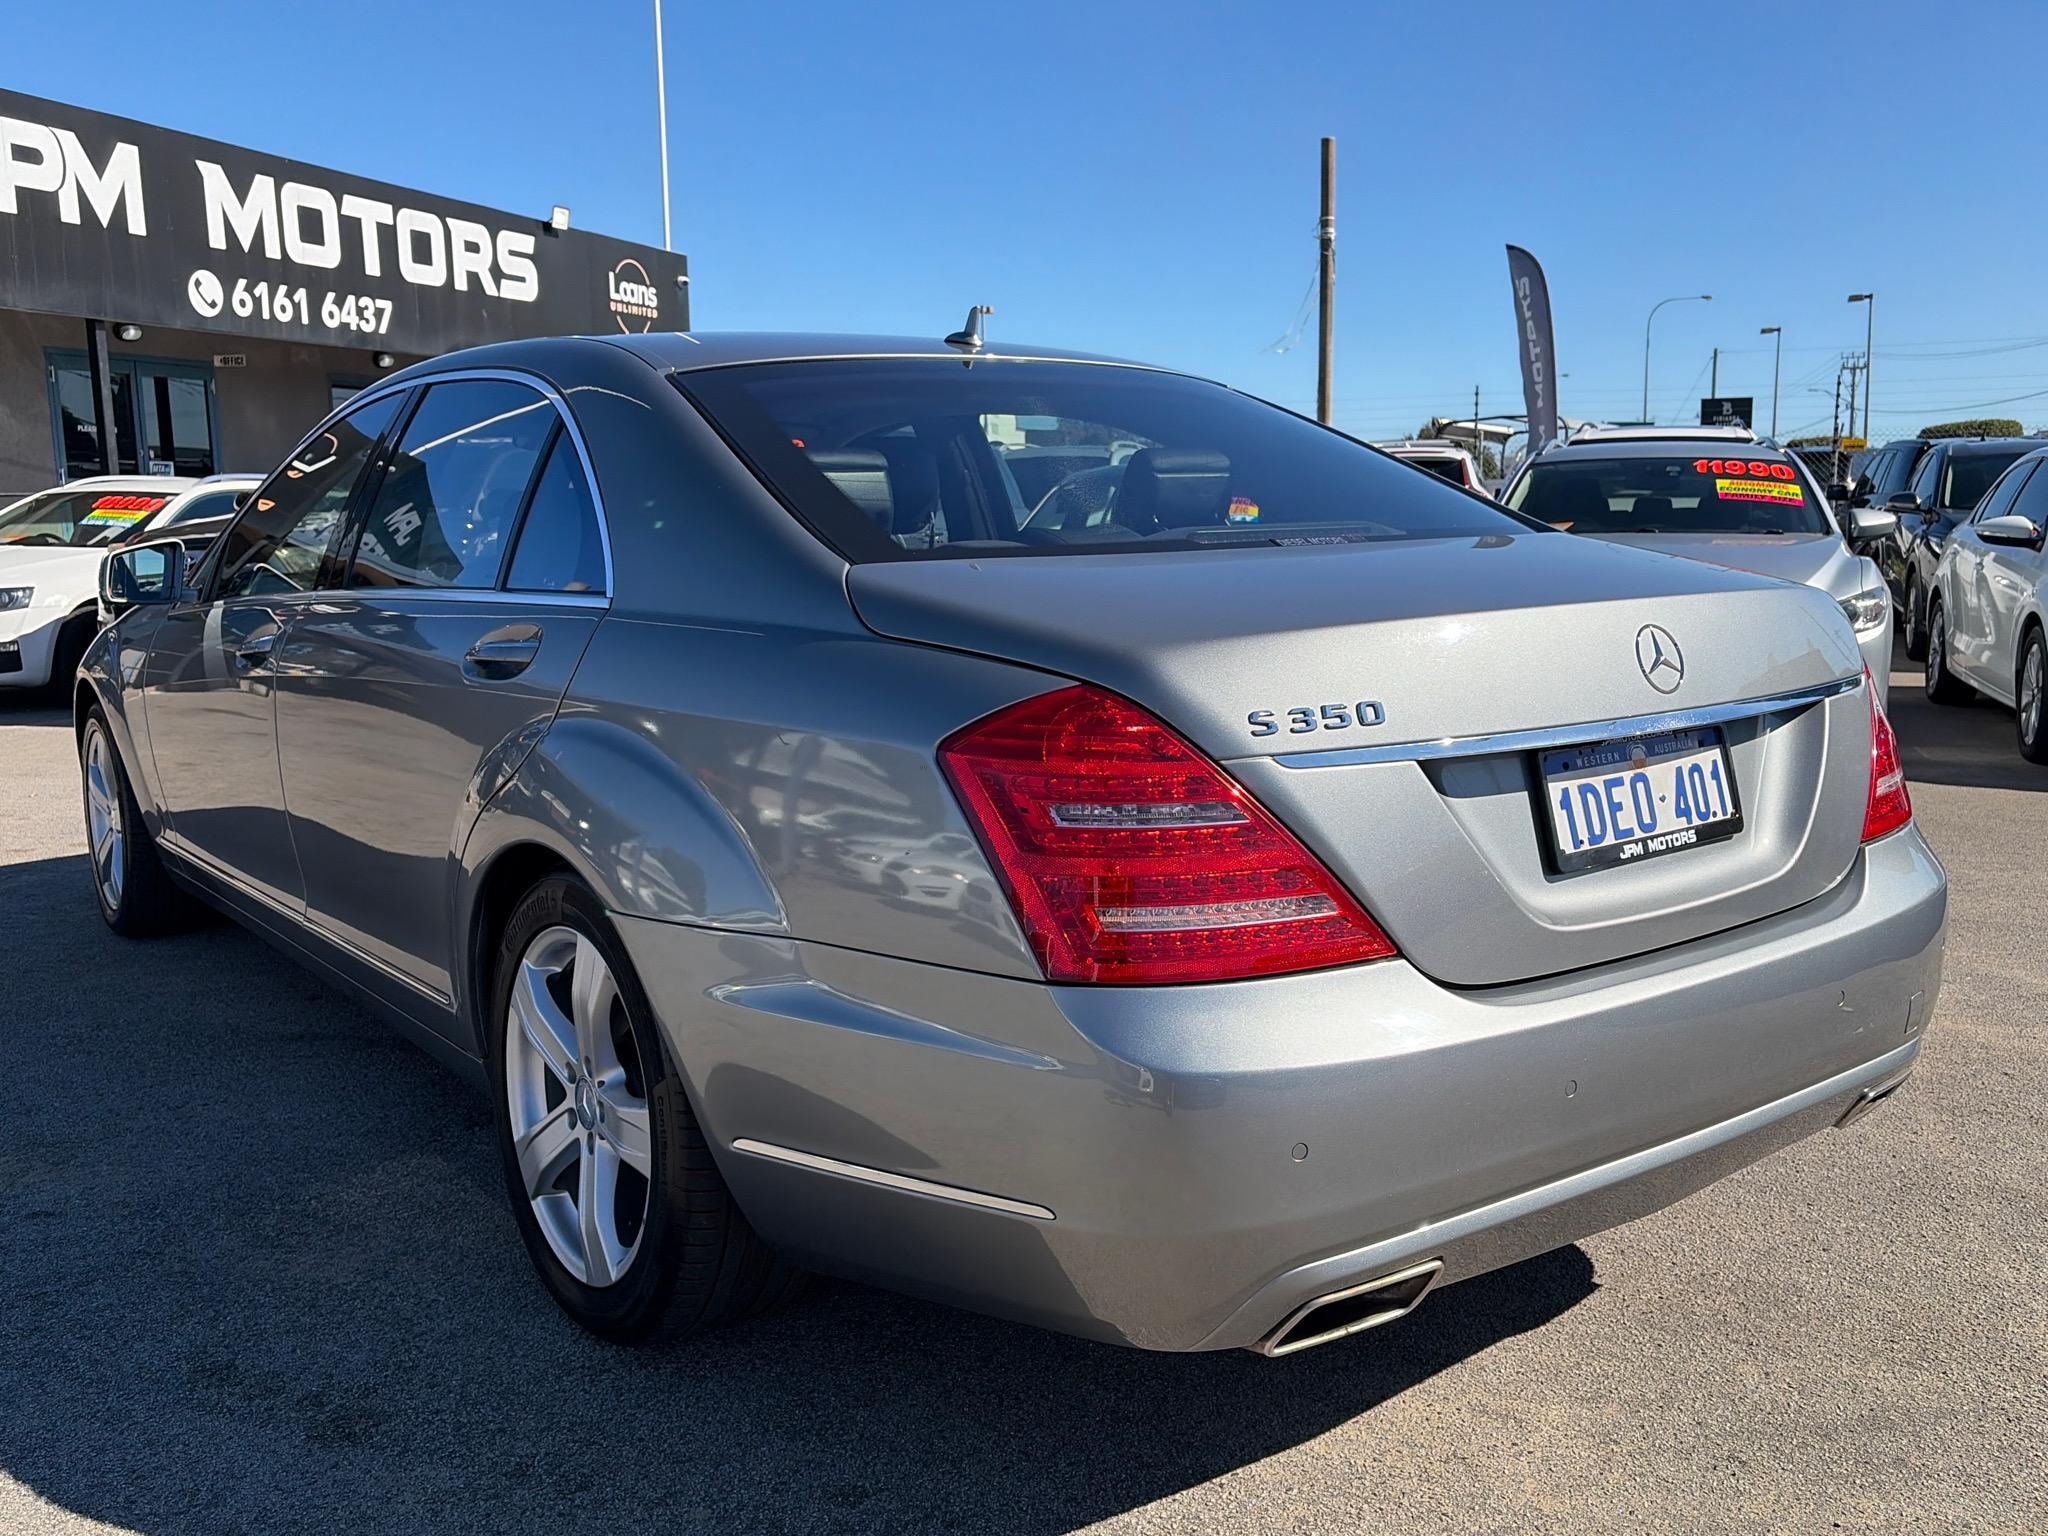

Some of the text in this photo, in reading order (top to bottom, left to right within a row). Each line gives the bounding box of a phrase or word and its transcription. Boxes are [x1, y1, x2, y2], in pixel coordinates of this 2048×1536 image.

[195, 160, 538, 302] MOTORS
[609, 271, 657, 307] Loans
[232, 278, 392, 334] 6161 6437
[610, 301, 658, 318] UNLIMITED
[1515, 276, 1544, 409] MOTORS
[222, 356, 244, 365] OFFICE
[1693, 459, 1797, 480] 11990
[1719, 486, 1801, 498] ECONOMY CAR
[1724, 492, 1768, 501] FAMILY
[1729, 480, 1790, 490] AUTOMATIC
[1248, 700, 1386, 738] S 350
[1575, 737, 1694, 768] WESTERN AUSTRALIA
[1619, 830, 1698, 860] JPM MOTORS
